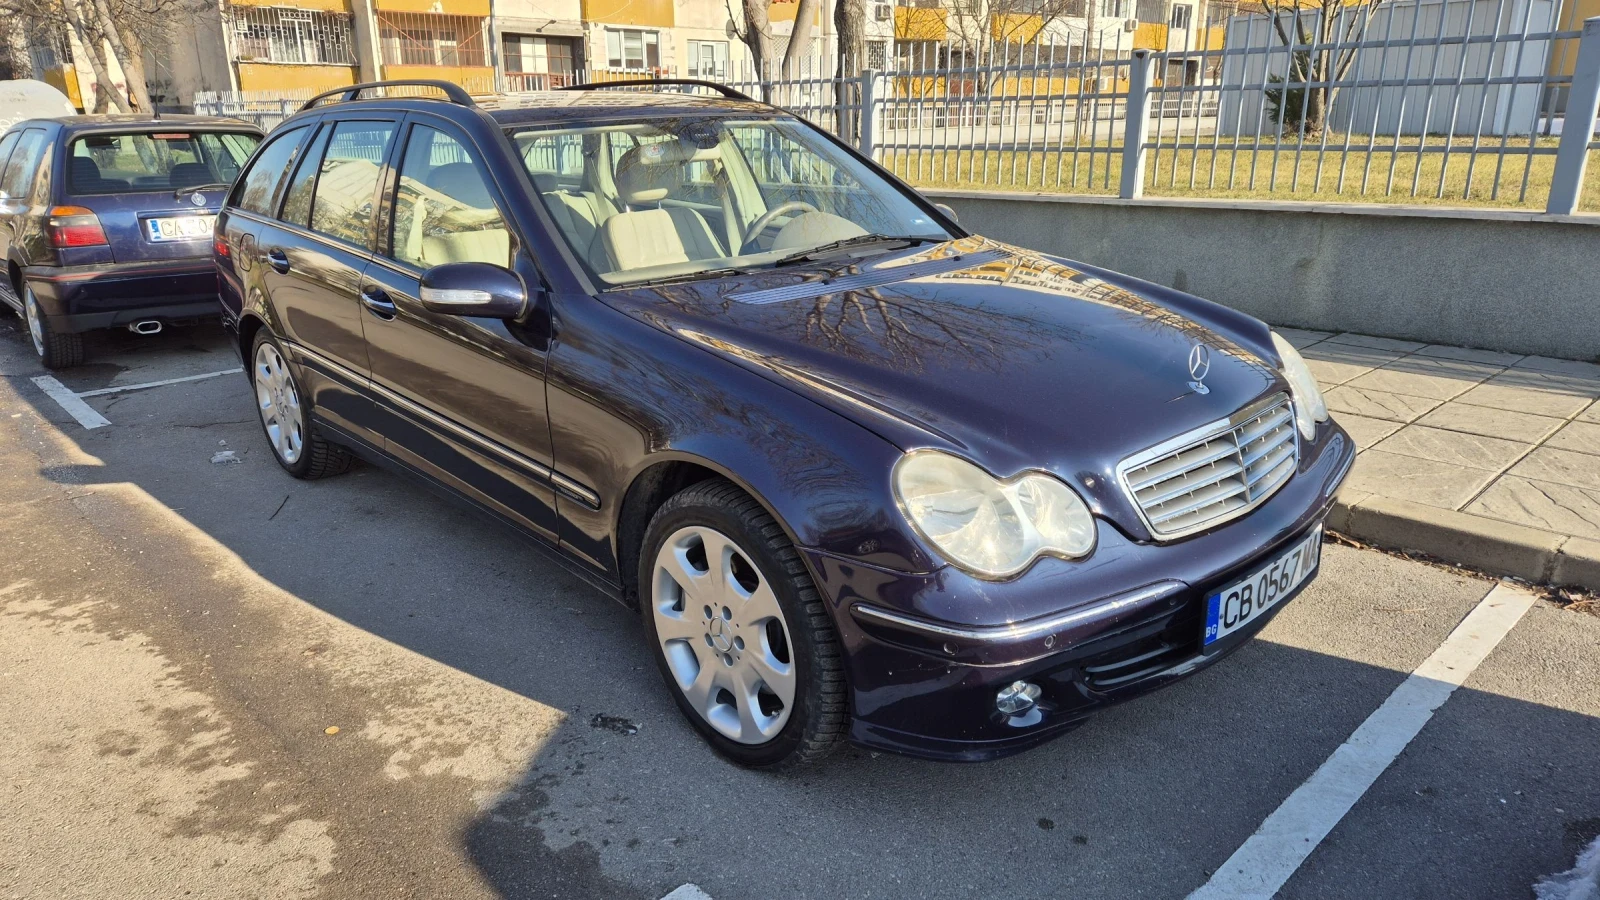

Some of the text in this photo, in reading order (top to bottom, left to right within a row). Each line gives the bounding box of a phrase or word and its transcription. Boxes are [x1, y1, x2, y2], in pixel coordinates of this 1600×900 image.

[1223, 583, 1253, 629] CB
[1257, 550, 1302, 609] 0567
[1205, 624, 1218, 638] BG
